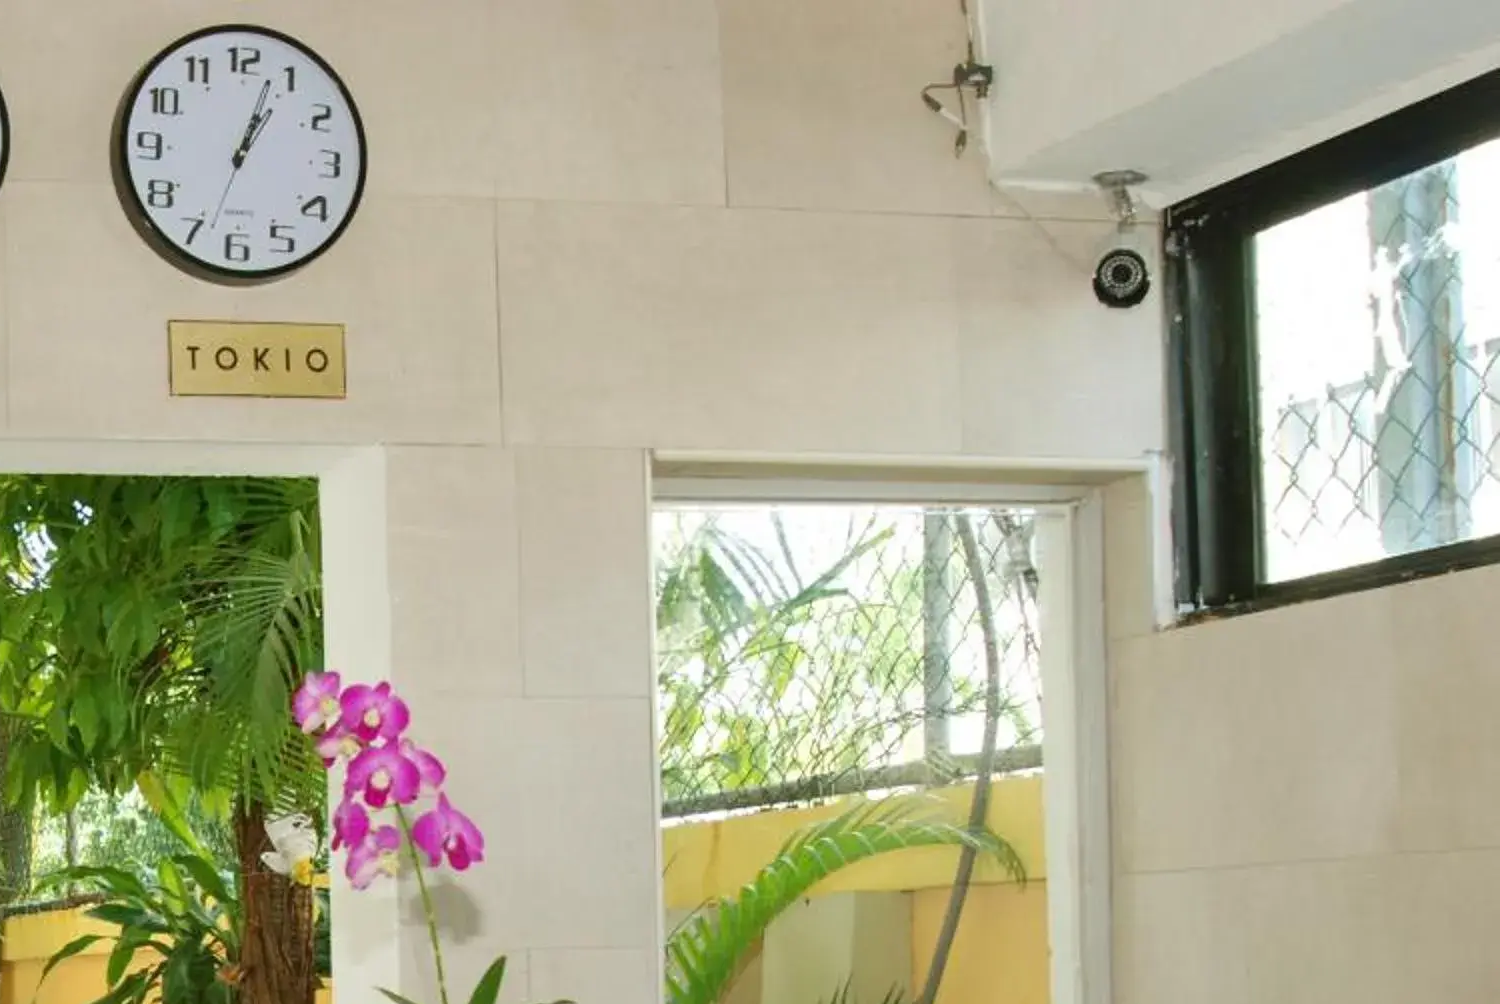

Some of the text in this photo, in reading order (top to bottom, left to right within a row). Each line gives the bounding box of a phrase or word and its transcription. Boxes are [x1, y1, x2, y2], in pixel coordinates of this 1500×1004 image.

[185, 56, 209, 84] 11
[228, 48, 260, 76] 12
[284, 66, 295, 92] 1
[150, 88, 179, 115] 10
[311, 104, 331, 132] 2
[137, 131, 163, 160] 9
[319, 150, 340, 178] 3
[148, 180, 174, 208] 8
[301, 196, 327, 222] 4
[181, 217, 204, 245] 7
[270, 225, 295, 253] 5
[225, 234, 250, 262] 6
[185, 345, 329, 374] TOKIO
